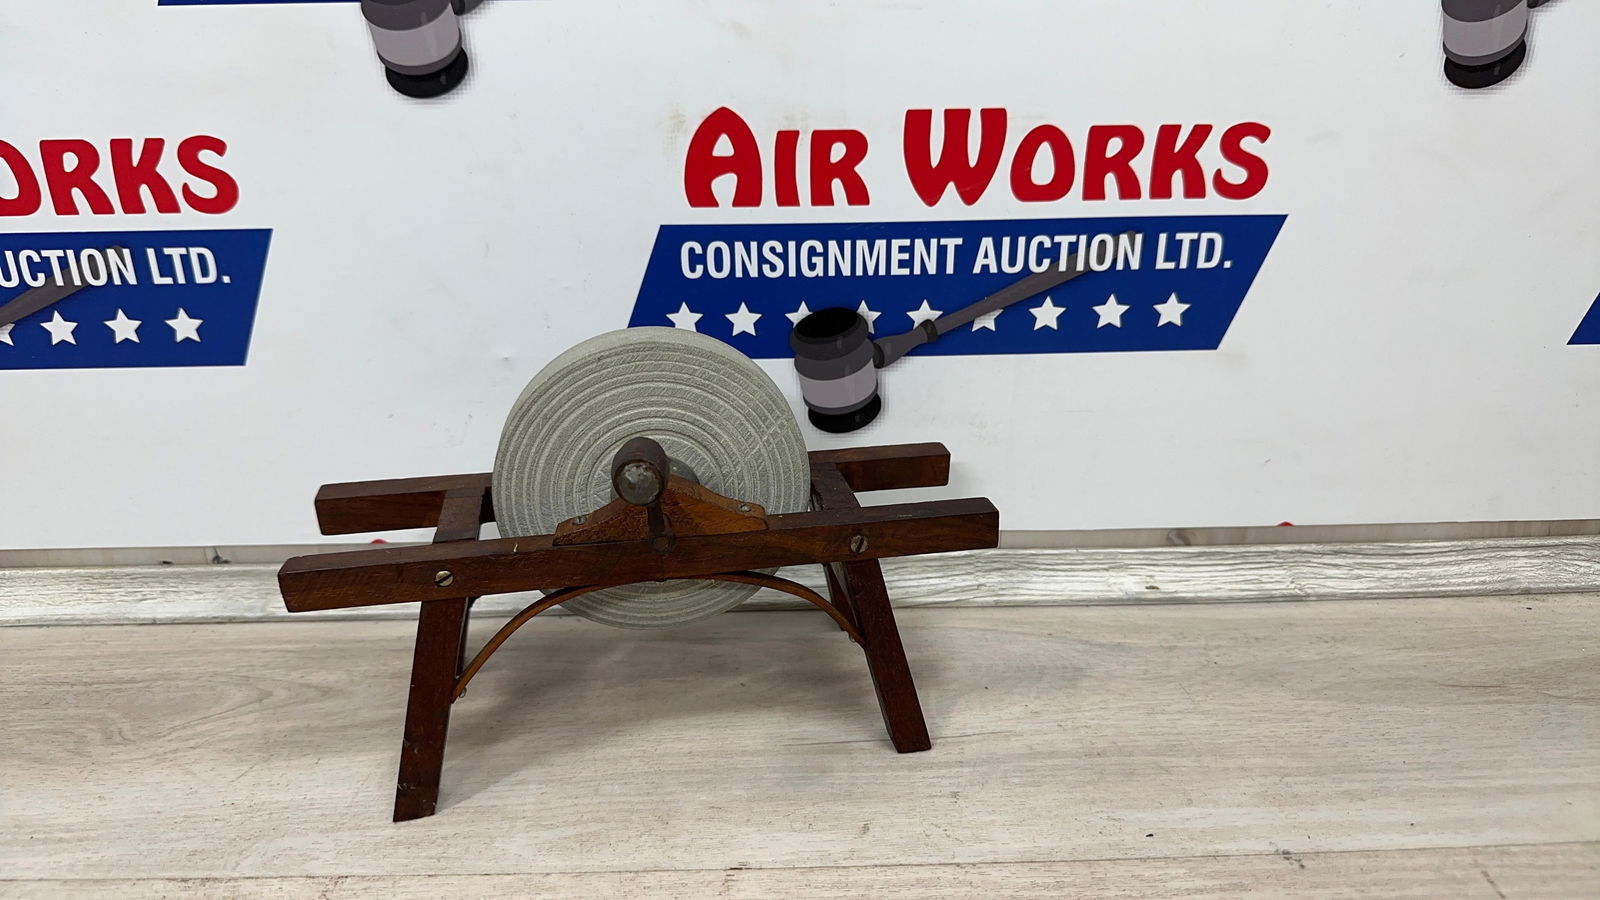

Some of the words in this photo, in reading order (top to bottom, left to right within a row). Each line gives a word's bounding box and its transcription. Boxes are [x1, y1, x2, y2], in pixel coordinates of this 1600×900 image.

[684, 107, 870, 208] AIR
[904, 107, 1272, 207] WORKS
[147, 247, 231, 285] LTD.
[680, 238, 963, 279] CONSIGNMENT
[973, 233, 1142, 274] AUCTION
[1155, 232, 1232, 270] LTD.
